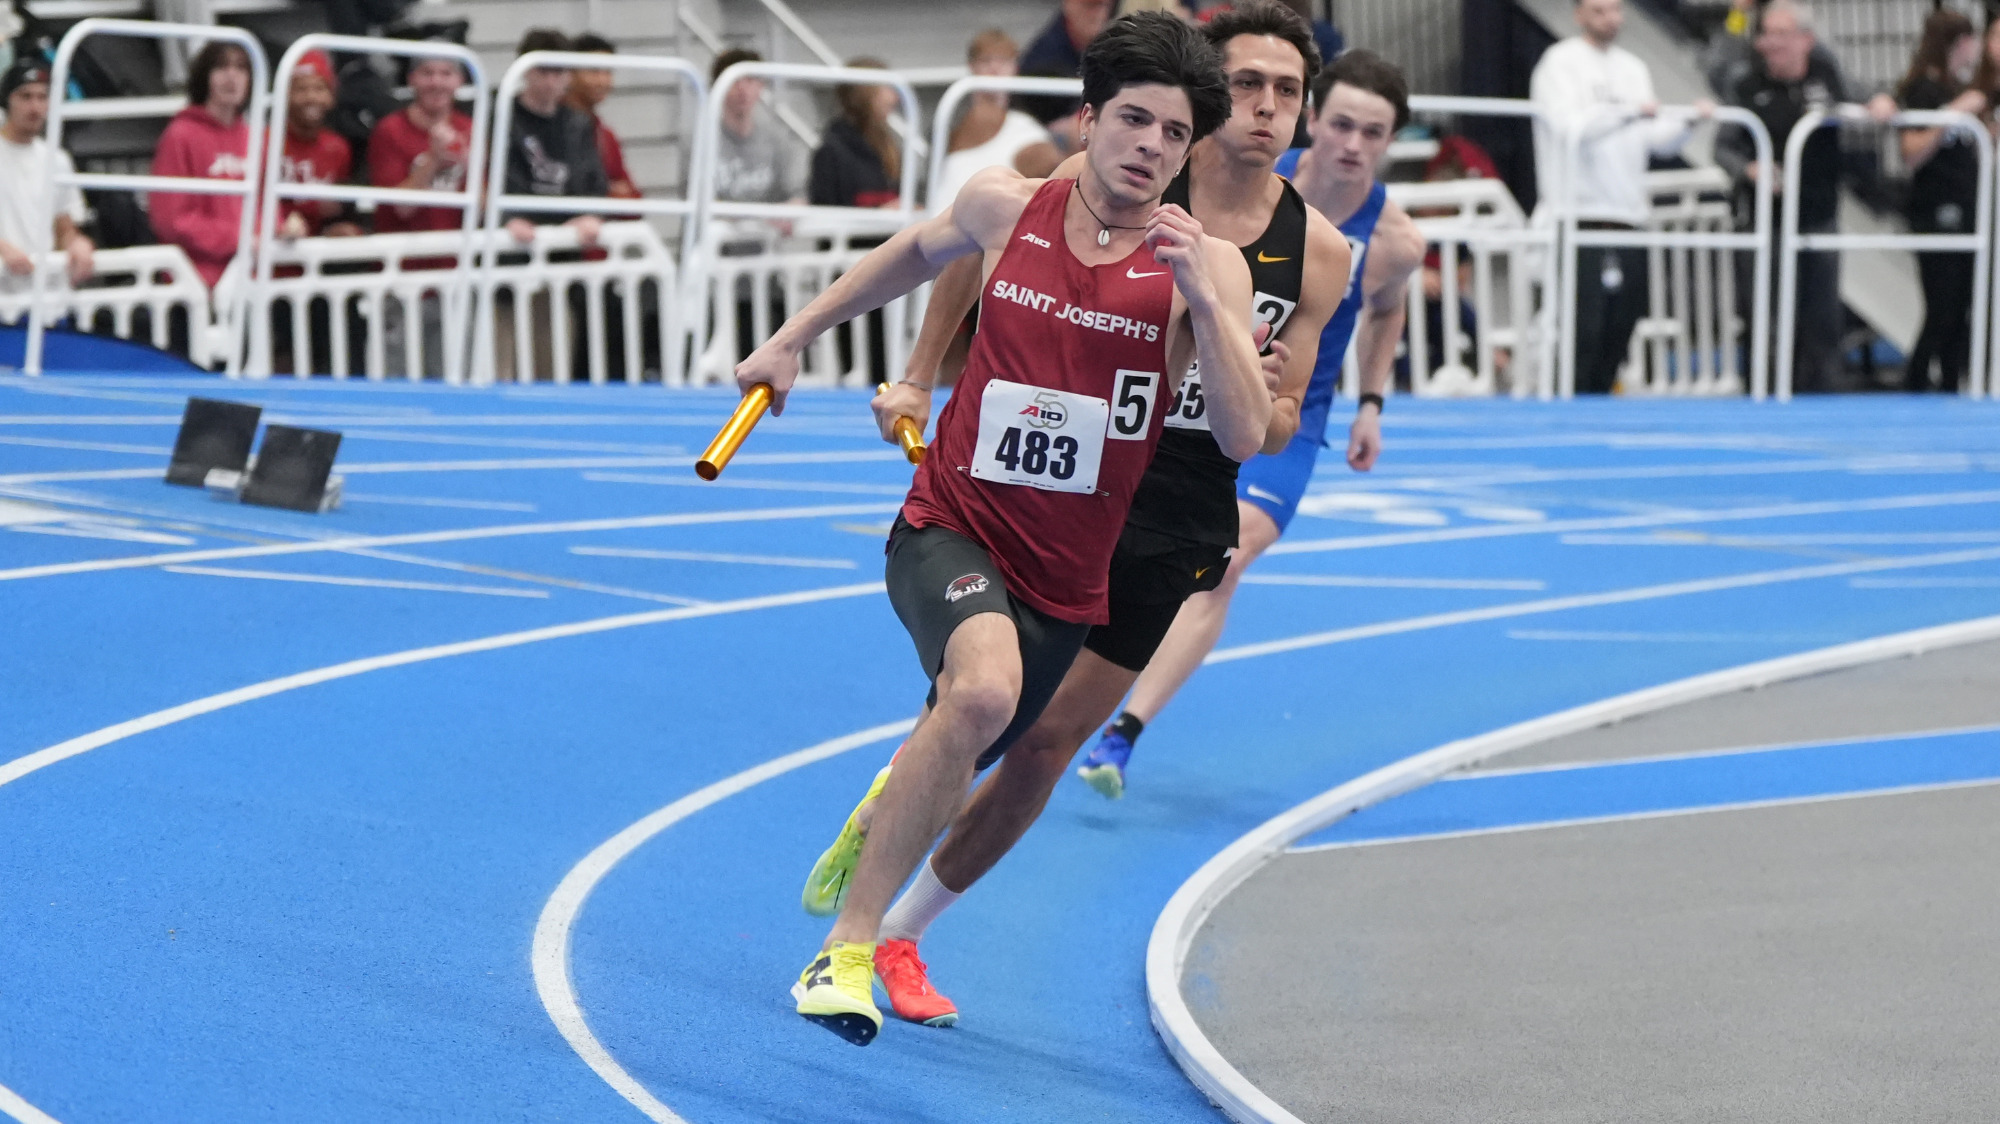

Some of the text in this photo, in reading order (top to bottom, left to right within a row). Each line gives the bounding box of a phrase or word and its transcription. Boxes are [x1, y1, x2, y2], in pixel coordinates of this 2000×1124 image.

[1020, 233, 1051, 249] A10
[992, 280, 1160, 342] SAINT JOSEPH'S
[1018, 404, 1063, 422] A10
[1115, 375, 1151, 435] 5
[995, 427, 1079, 480] 483
[951, 584, 984, 599] SJU
